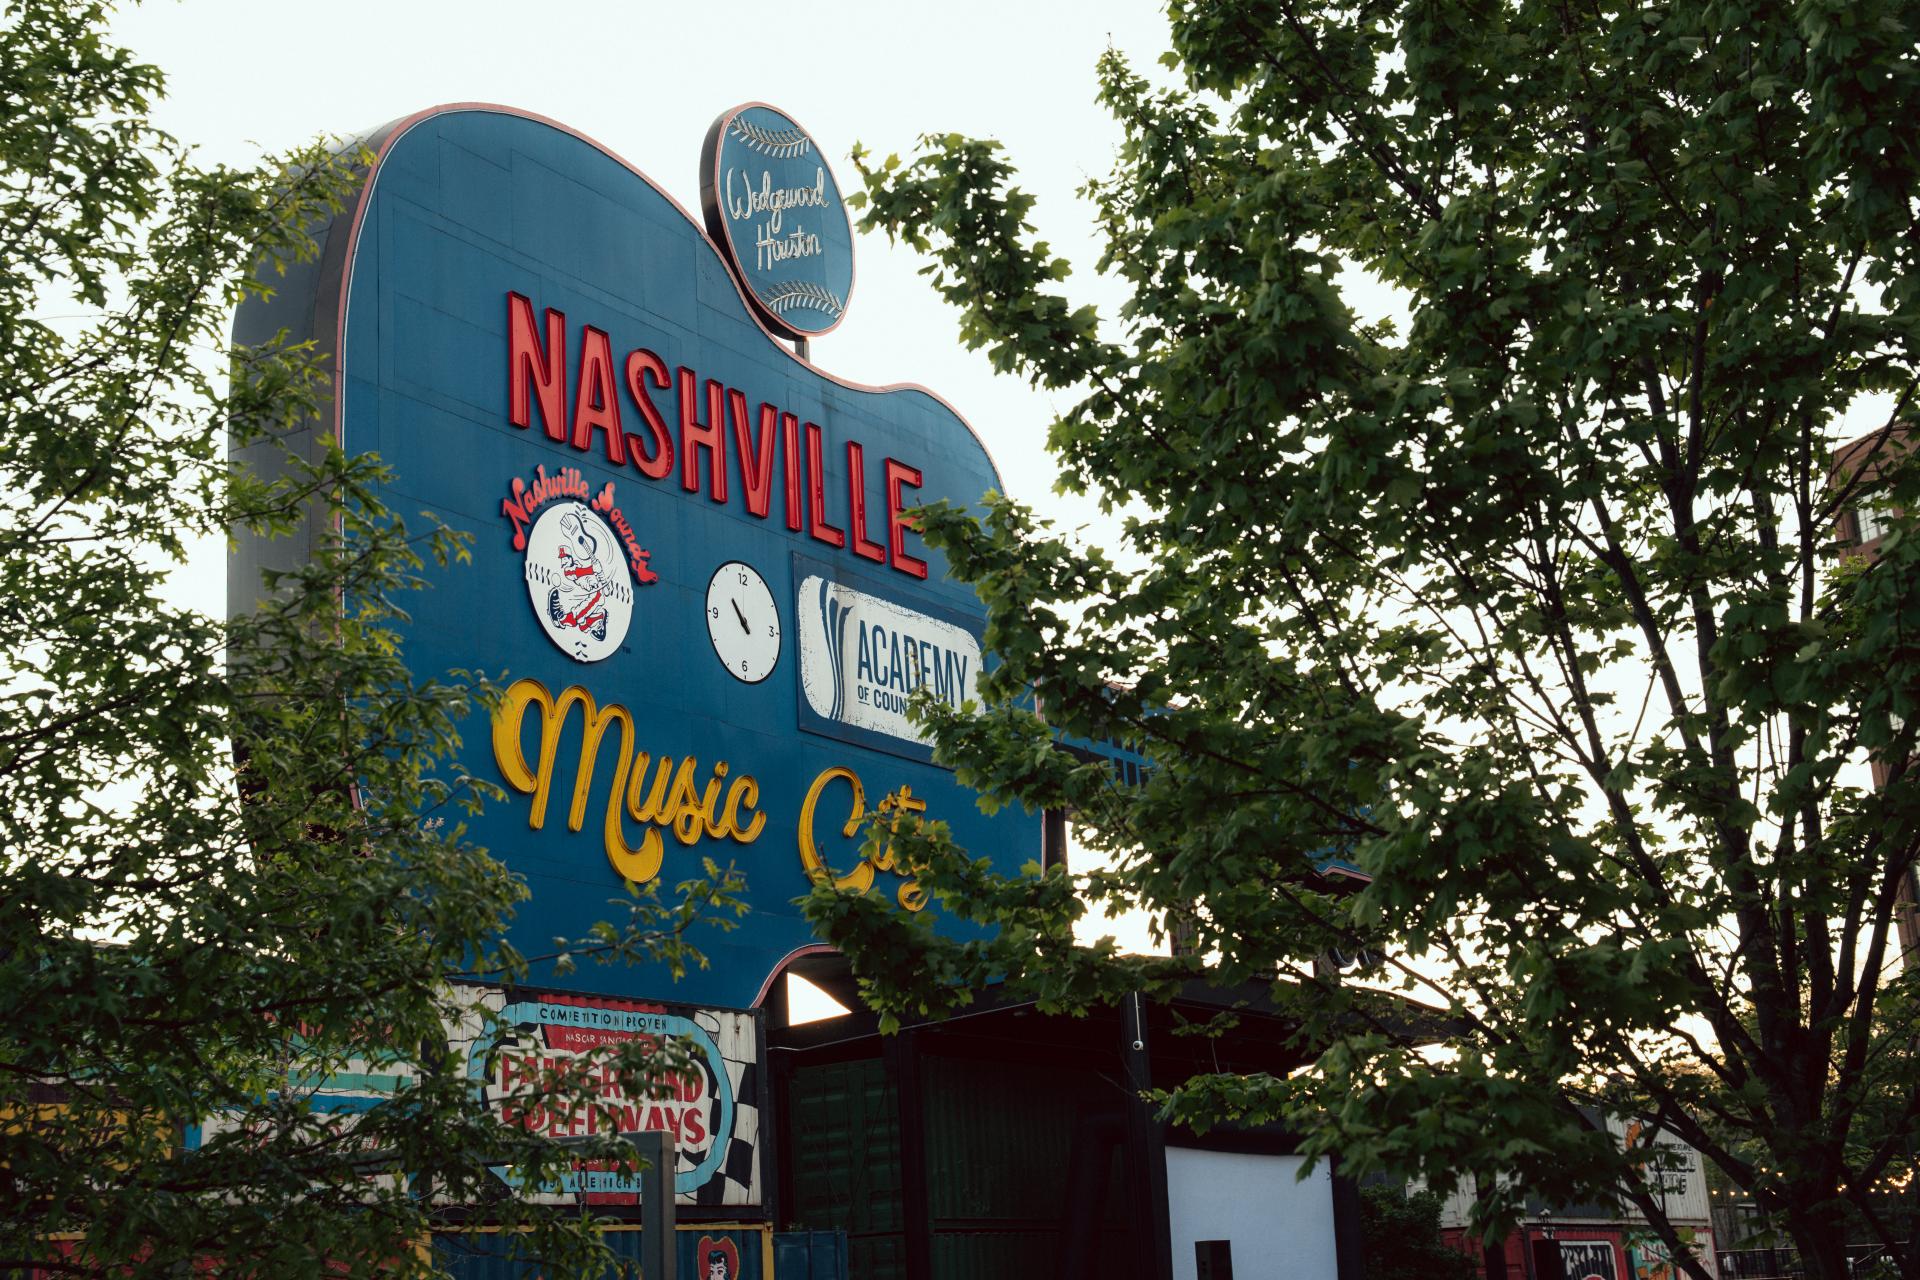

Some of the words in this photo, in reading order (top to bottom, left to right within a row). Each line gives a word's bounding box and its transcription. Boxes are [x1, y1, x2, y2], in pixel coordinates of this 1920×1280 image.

[726, 166, 830, 234] Wedgewood
[755, 221, 822, 271] Houston
[507, 290, 928, 580] NASHVILLE
[503, 464, 590, 551] Nashville
[591, 481, 659, 585] Sounds
[738, 573, 749, 587] 12
[712, 607, 719, 619] 9
[768, 626, 775, 638] 3
[741, 660, 748, 672] 6
[857, 620, 968, 709] ACADEMY
[857, 685, 870, 702] OF
[492, 678, 767, 884] Music
